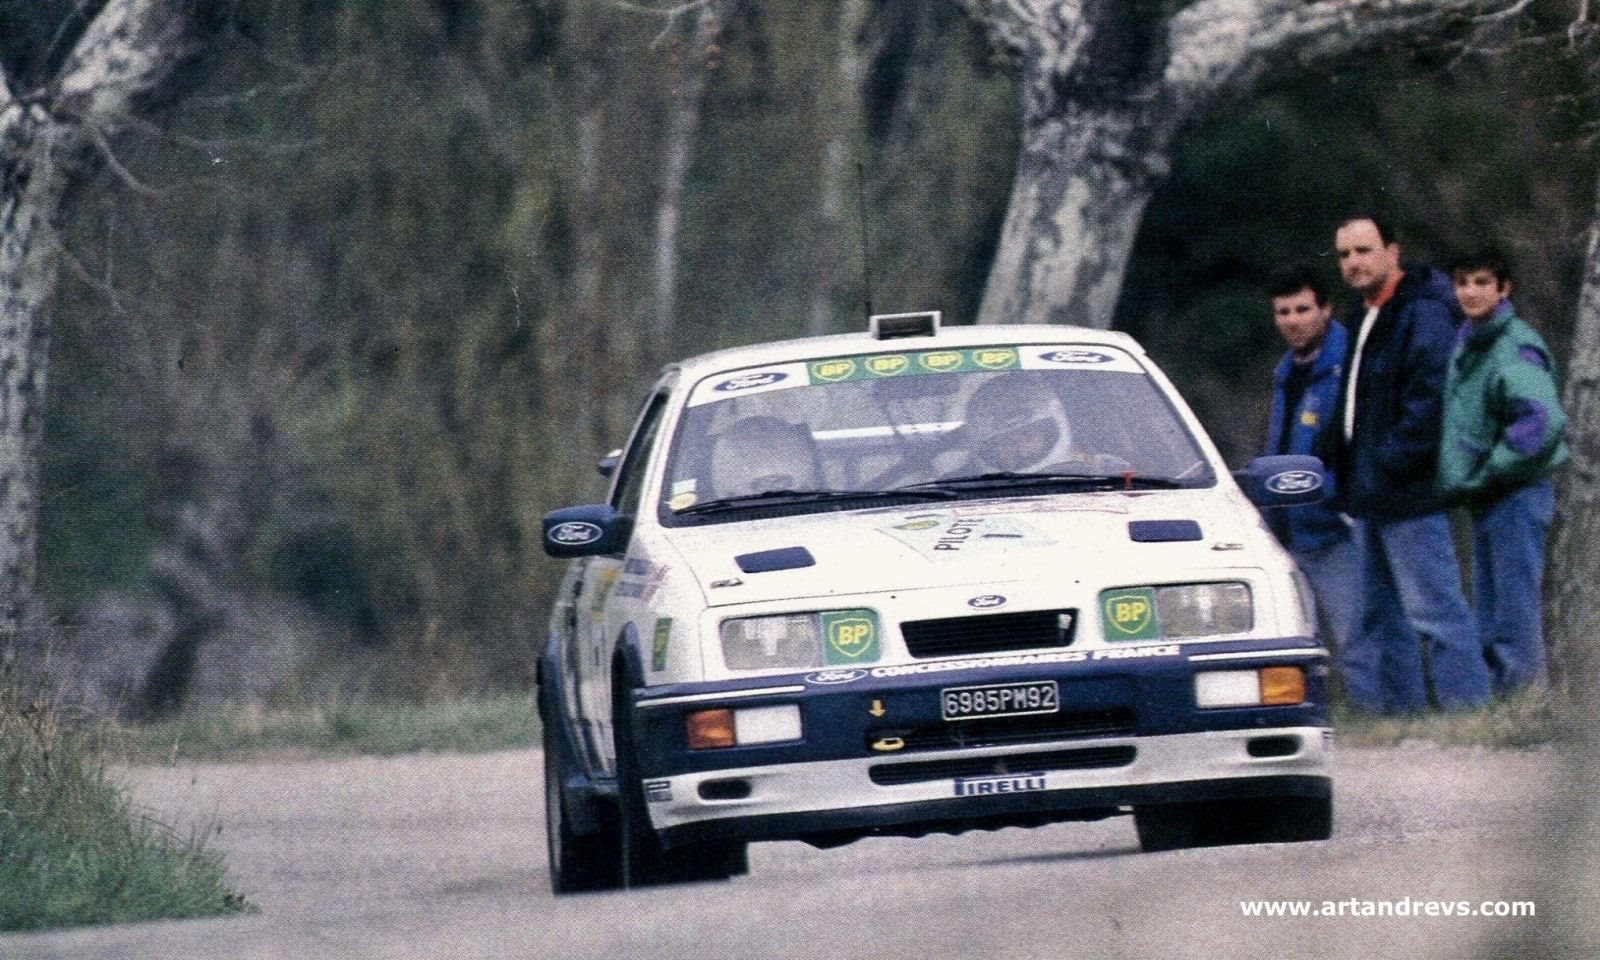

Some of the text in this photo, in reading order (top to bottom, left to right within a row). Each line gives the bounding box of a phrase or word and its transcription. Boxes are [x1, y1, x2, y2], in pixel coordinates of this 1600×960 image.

[820, 351, 1011, 377] BP BP BP BP
[1047, 350, 1105, 363] Ford
[722, 372, 778, 391] Ford
[1275, 472, 1315, 491] Ford
[556, 524, 594, 542] Ford
[934, 518, 985, 550] PILOTE
[971, 595, 1003, 607] Ford
[1116, 602, 1147, 621] BP
[838, 624, 869, 645] BP
[871, 644, 1180, 678] CONCESSIONNAIRES FRANCE
[814, 669, 858, 682] Ford
[946, 686, 1055, 715] 6985PM92
[953, 774, 1046, 796] PIRELLI
